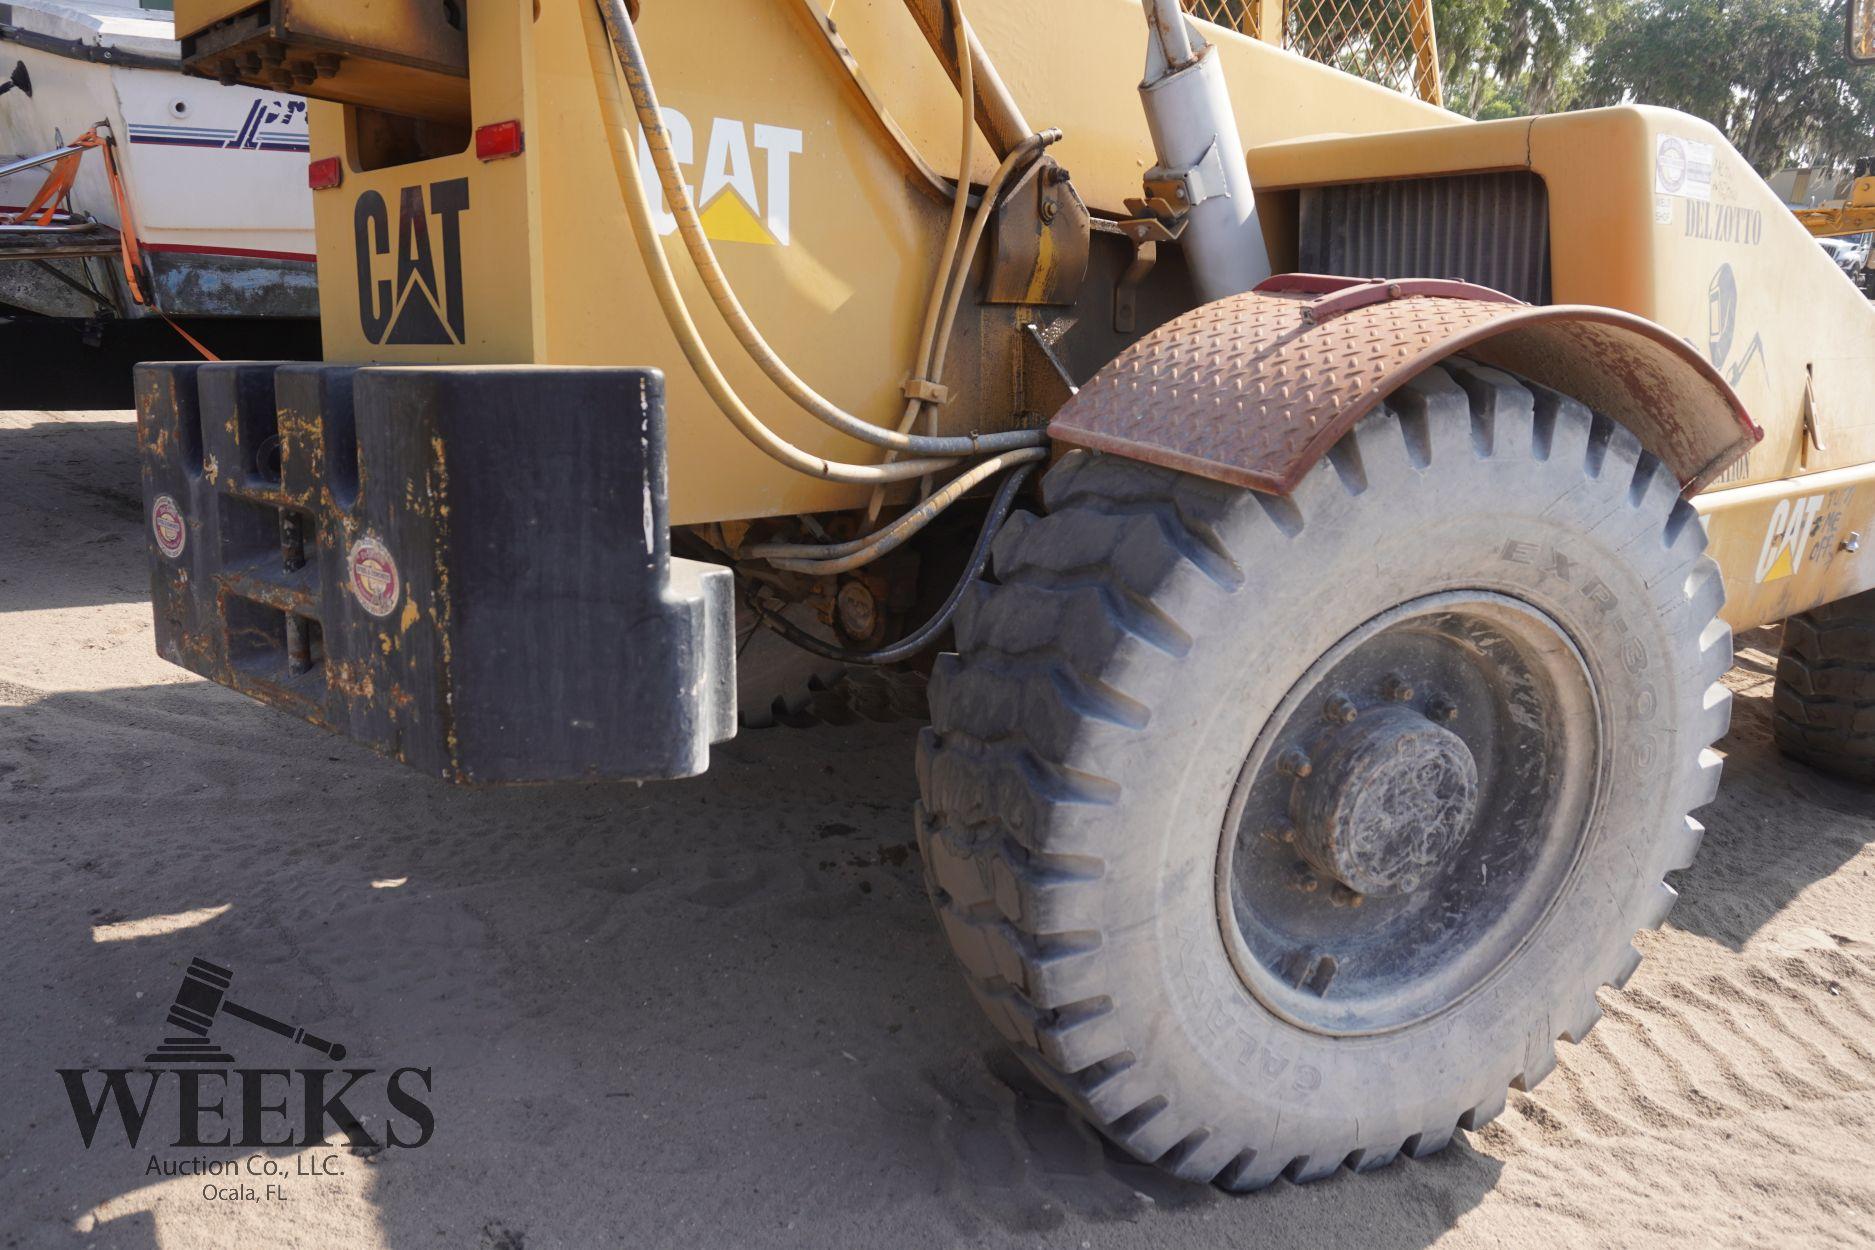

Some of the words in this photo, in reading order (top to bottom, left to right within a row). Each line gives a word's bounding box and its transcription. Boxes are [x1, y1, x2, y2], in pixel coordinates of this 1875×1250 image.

[638, 107, 803, 246] CAT
[1685, 198, 1712, 239] DEL
[1714, 204, 1761, 245] ZOTTO
[354, 177, 469, 345] CAT
[1755, 494, 1824, 583] CAT
